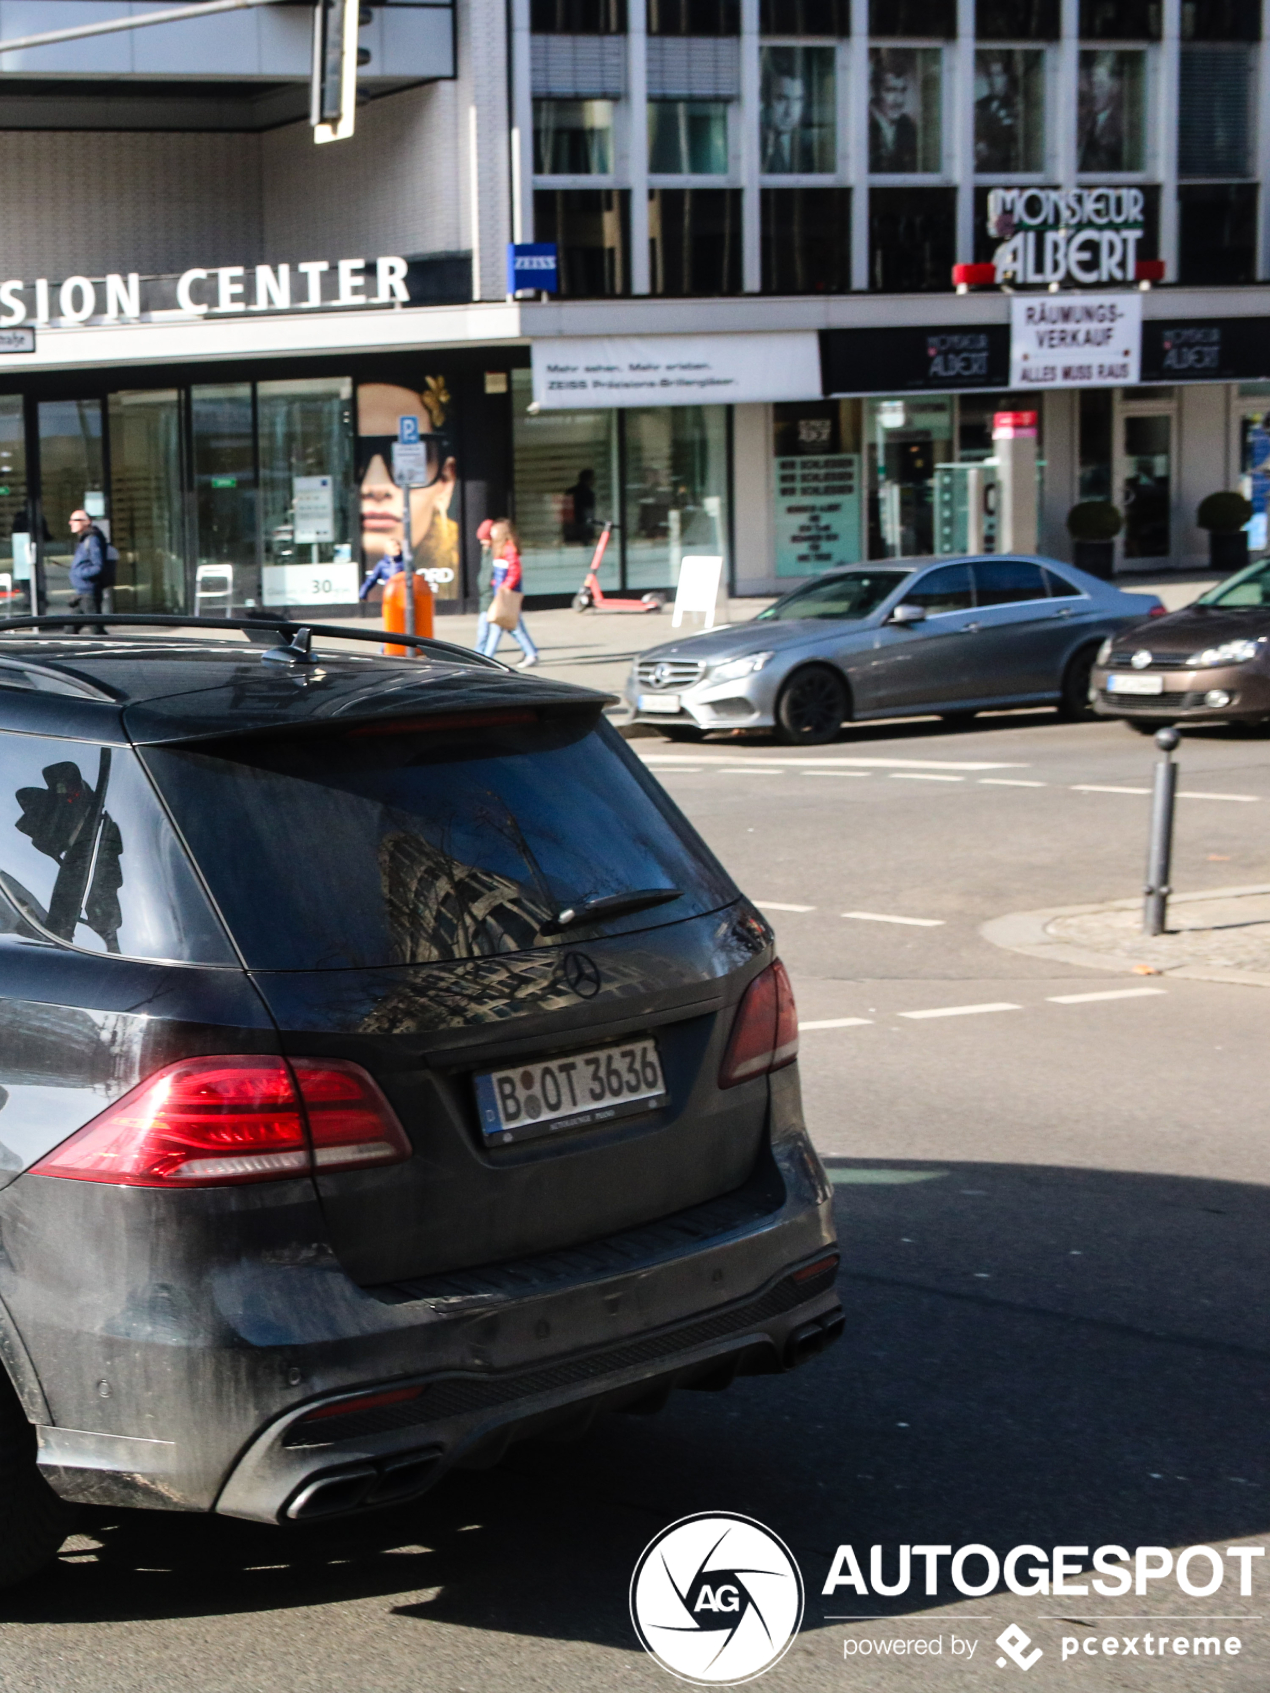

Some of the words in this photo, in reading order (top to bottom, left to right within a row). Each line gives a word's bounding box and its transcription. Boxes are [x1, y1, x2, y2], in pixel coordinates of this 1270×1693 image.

[988, 187, 1145, 228] MONSIEUR
[514, 256, 557, 270] ZEISS
[993, 230, 1144, 283] ALBERT
[176, 257, 410, 314] CENTER
[1026, 303, 1124, 325] RÄUMUNGS-
[1036, 327, 1114, 349] VERKAUF
[546, 363, 578, 373] Mehr
[629, 362, 661, 372] Mehr
[929, 353, 989, 377] ALBERT
[1020, 365, 1057, 382] ALLES
[1062, 364, 1093, 381] MUSS
[1098, 362, 1130, 379] RAUS
[547, 379, 587, 390] ZEISS
[311, 579, 332, 594] 30
[497, 1075, 521, 1122] B
[541, 1062, 578, 1112] OT
[584, 1047, 658, 1101] 3636
